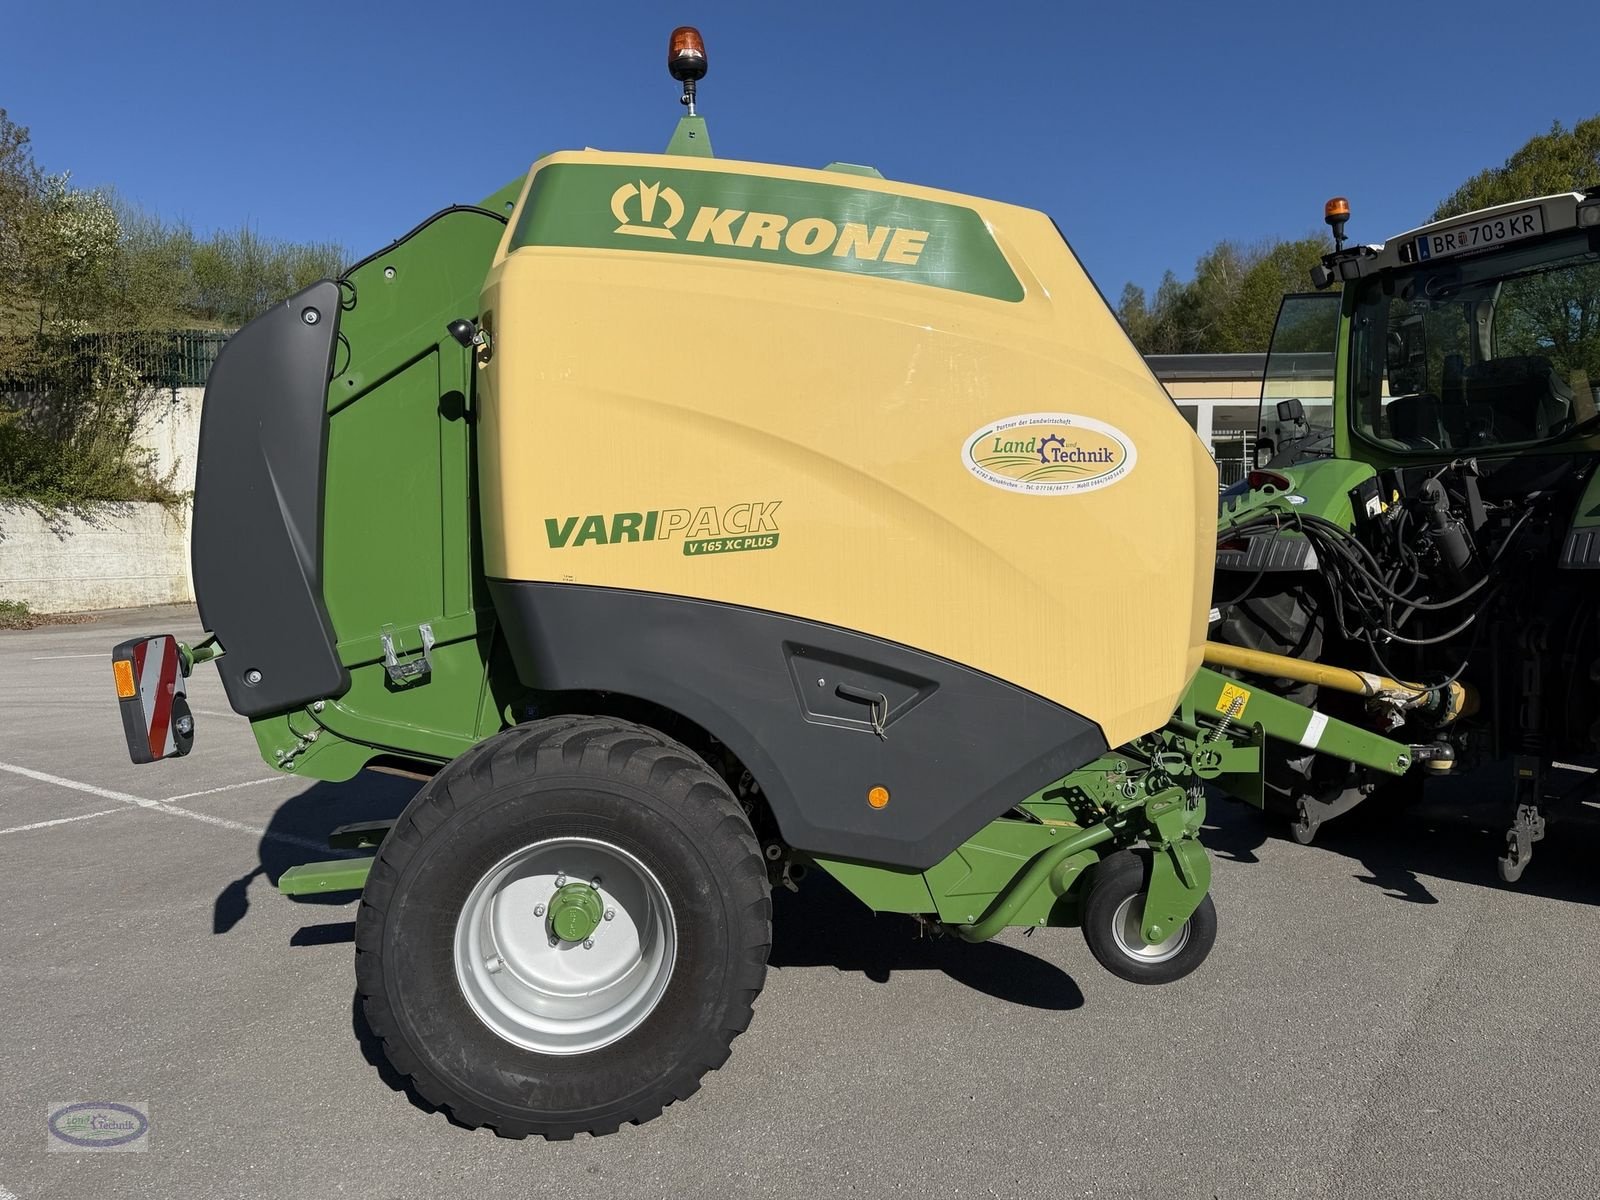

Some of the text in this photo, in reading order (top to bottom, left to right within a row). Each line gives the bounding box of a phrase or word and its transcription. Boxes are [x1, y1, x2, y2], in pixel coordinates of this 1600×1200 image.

[686, 206, 930, 265] KRONE
[1433, 214, 1535, 253] BR 703 KR
[996, 417, 1072, 431] Partner der Landwirtschaft
[993, 436, 1037, 453] Land
[1051, 447, 1114, 463] Technik
[544, 500, 783, 549] VARIPACK
[689, 536, 774, 553] V 165 XC PLUS
